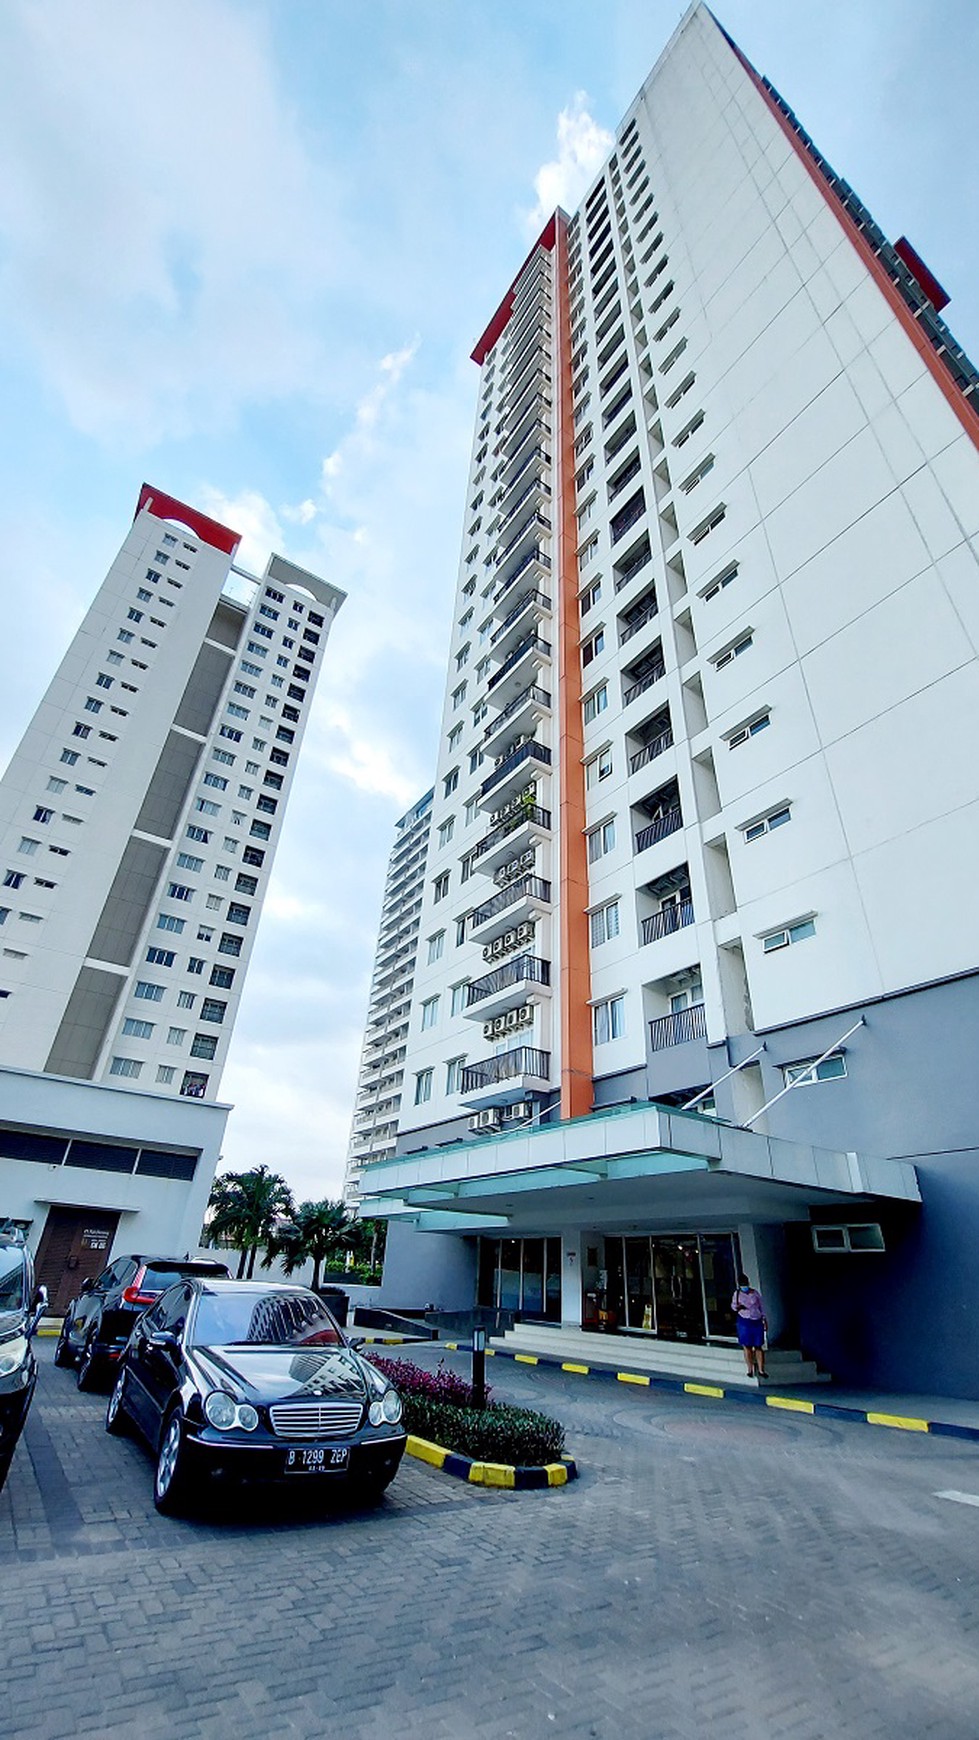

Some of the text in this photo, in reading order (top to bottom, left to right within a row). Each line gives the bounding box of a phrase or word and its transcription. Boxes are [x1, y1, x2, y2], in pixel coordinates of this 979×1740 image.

[288, 1448, 347, 1465] B 1299 ZEP
